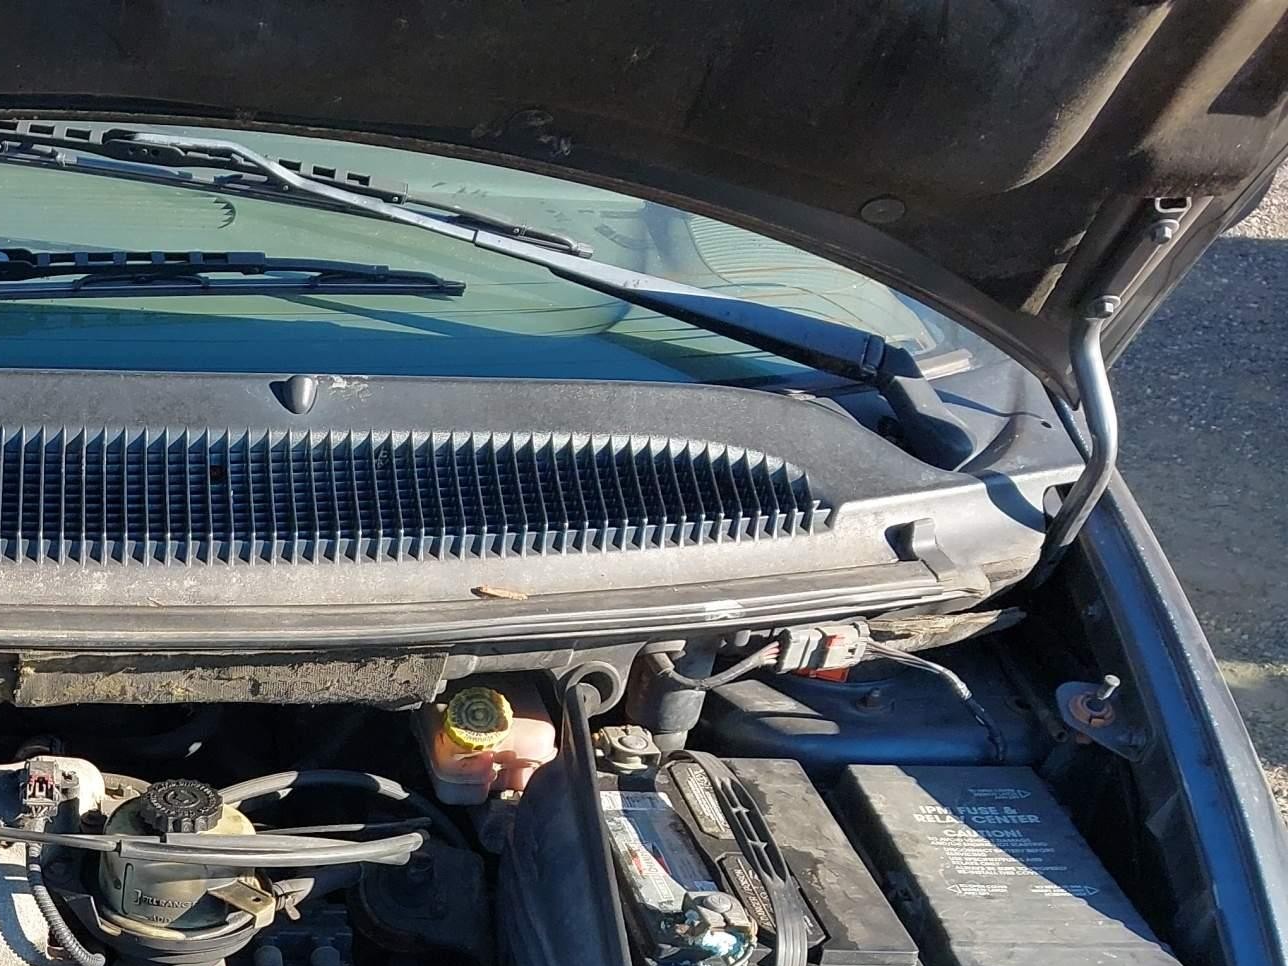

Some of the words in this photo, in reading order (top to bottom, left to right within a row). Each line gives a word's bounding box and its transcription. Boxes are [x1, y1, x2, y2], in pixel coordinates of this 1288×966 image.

[957, 806, 999, 815] FUSE
[1004, 806, 1018, 815] &
[913, 814, 965, 824] RELAY
[971, 815, 1041, 824] CENTER
[943, 829, 1024, 838] CAUTION!
